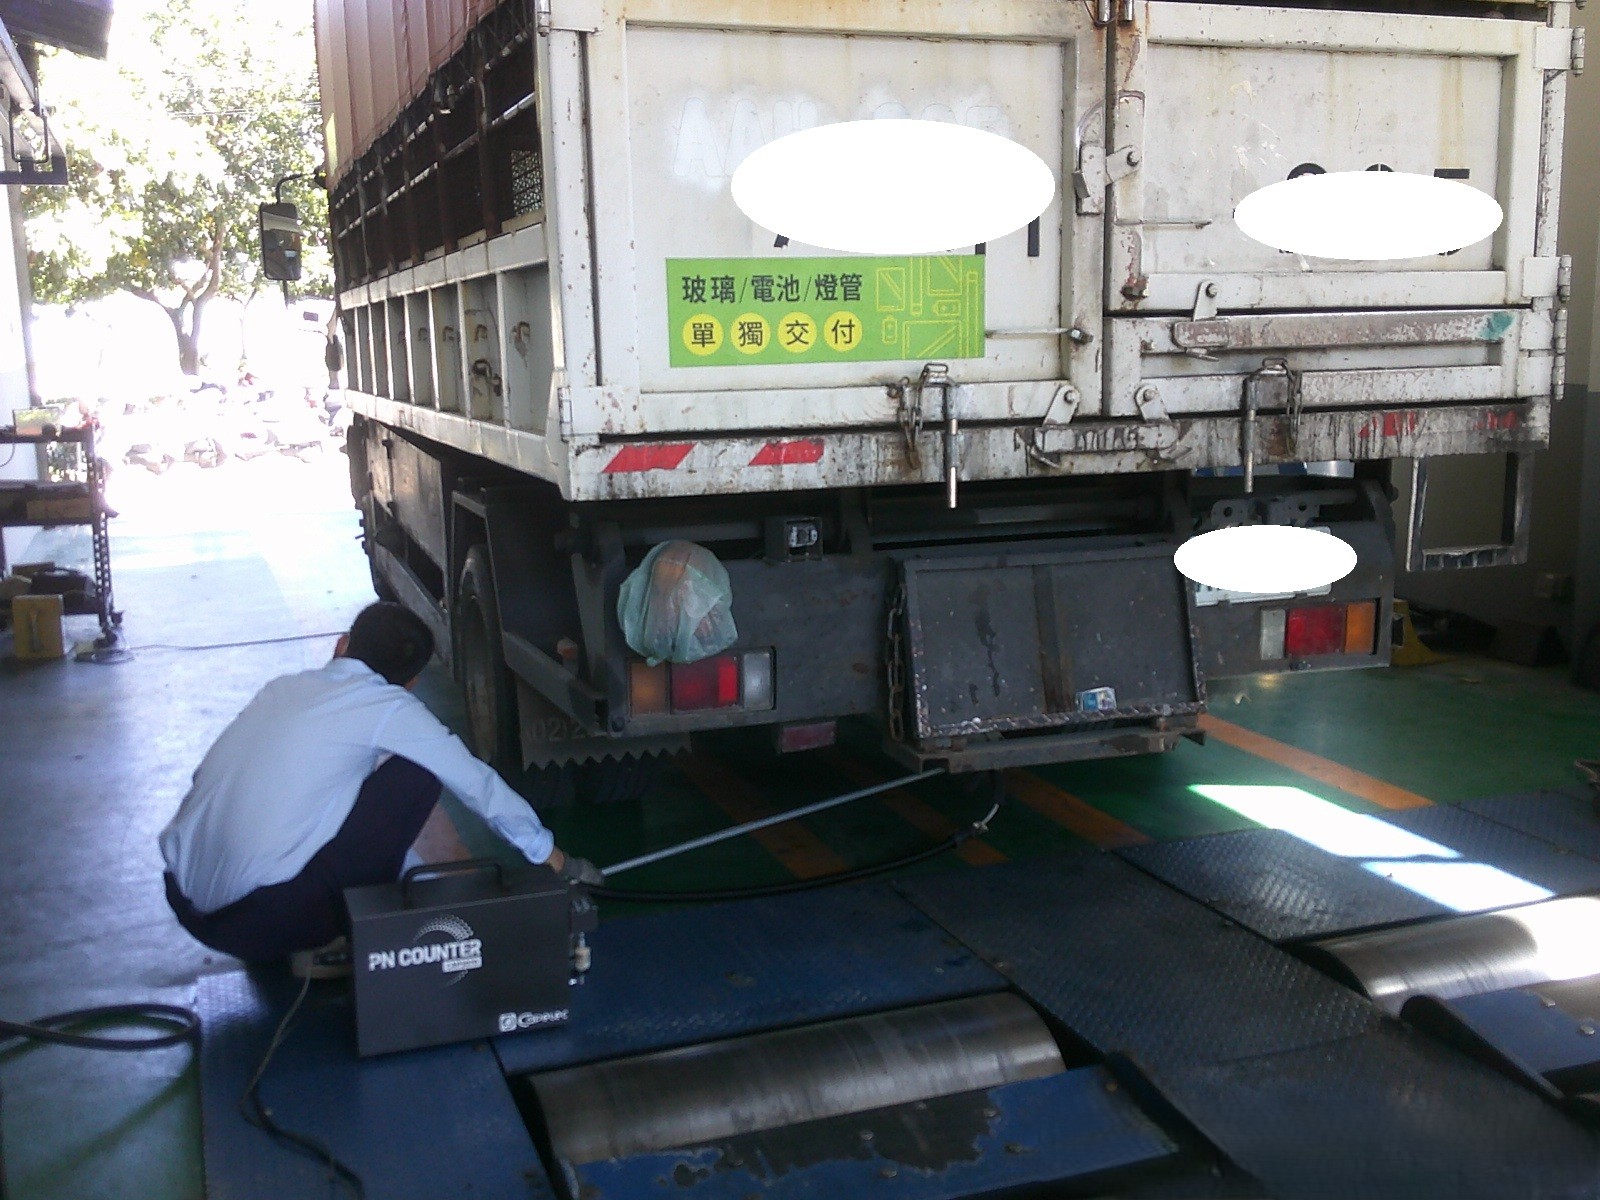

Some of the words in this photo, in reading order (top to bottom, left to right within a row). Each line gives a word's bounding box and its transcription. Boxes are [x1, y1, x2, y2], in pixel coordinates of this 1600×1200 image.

[682, 272, 862, 303] 玻璃/電池/燈管
[691, 319, 856, 348] 單獨交付
[368, 950, 396, 972] PN
[398, 938, 483, 967] COUNTER
